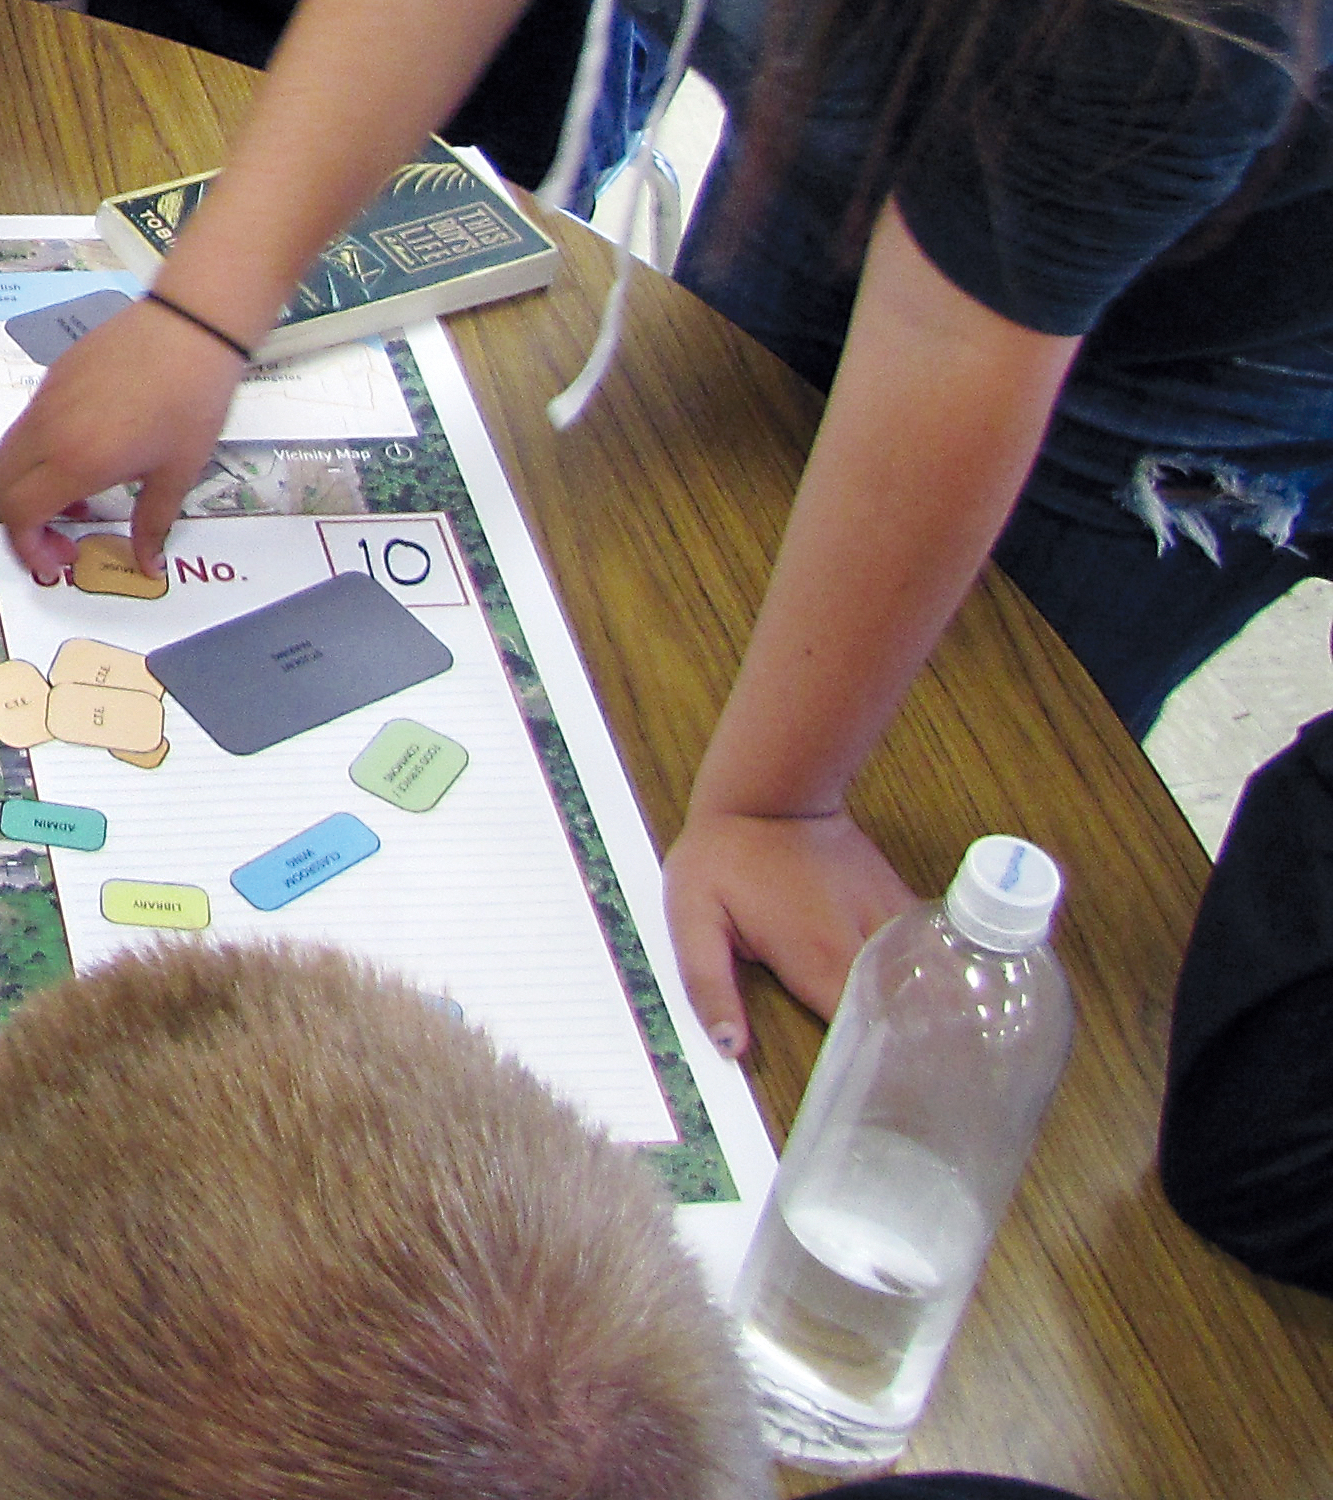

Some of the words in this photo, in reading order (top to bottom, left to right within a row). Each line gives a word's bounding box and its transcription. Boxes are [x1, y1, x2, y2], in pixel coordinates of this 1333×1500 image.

[458, 207, 511, 246] THIS
[398, 225, 453, 264] LIFE
[272, 448, 332, 462] Vicinity
[335, 448, 371, 462] Map
[175, 557, 248, 583] No.
[358, 538, 431, 586] 10
[33, 818, 75, 832] ADMIN
[133, 900, 182, 912] LIBRARY
